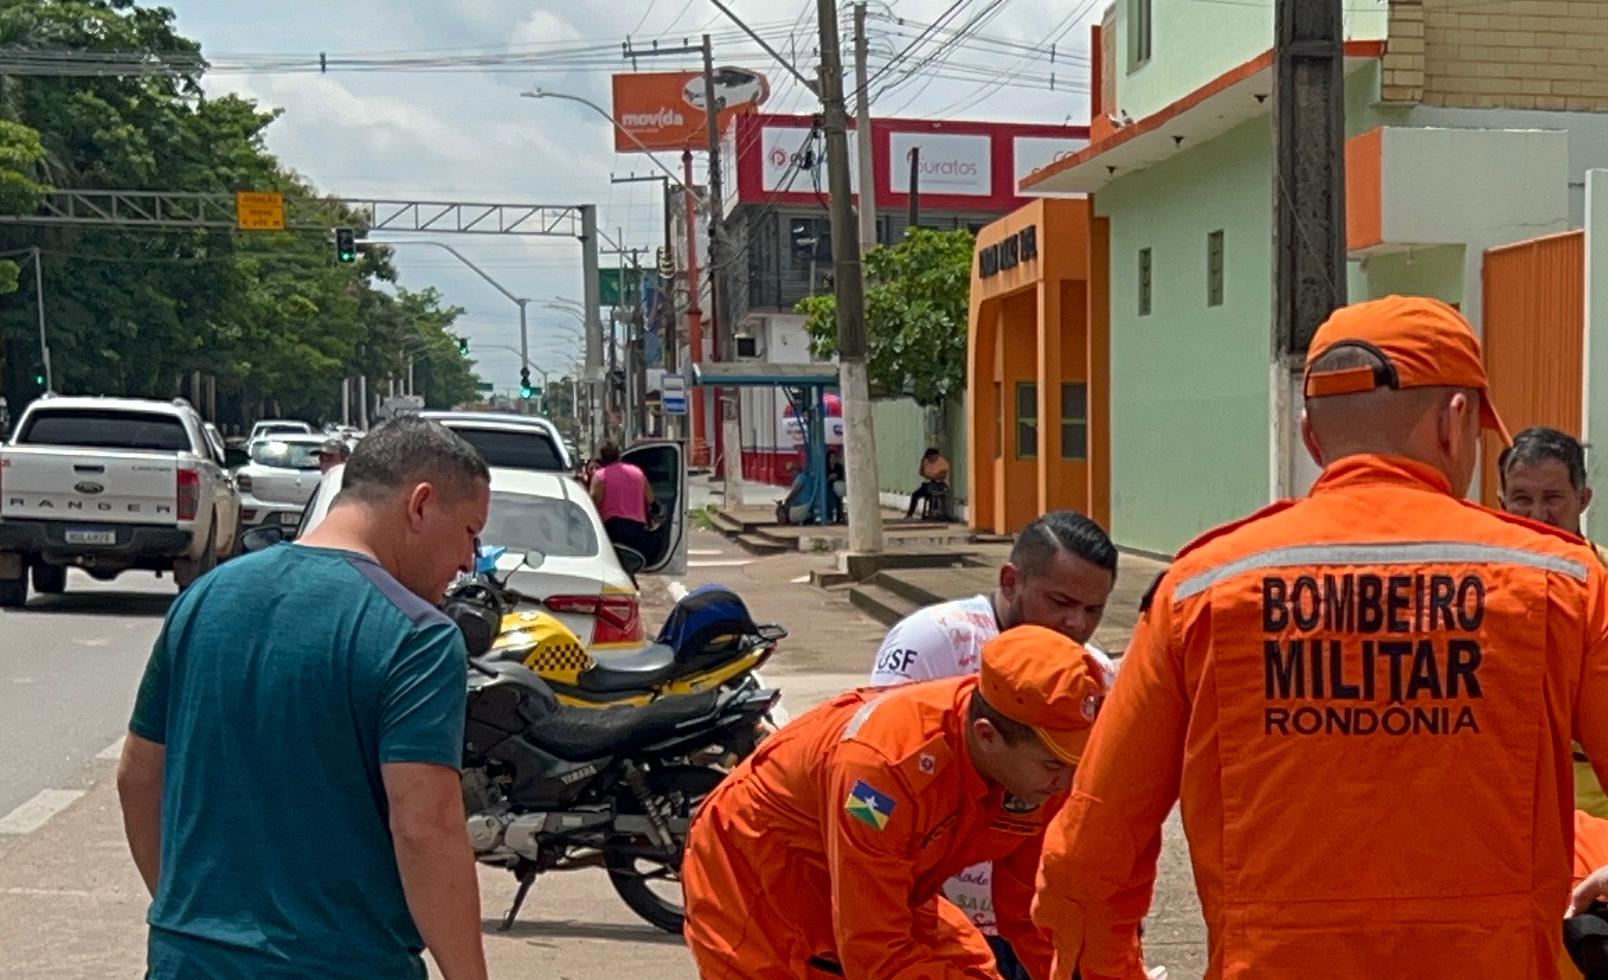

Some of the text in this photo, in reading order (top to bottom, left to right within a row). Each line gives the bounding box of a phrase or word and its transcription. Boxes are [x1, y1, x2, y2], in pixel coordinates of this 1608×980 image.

[9, 497, 171, 514] RANGER
[1262, 575, 1484, 634] BOMBEIRO
[1264, 639, 1483, 701] MILITAR
[1263, 694, 1481, 736] RONDÔNIA
[560, 764, 598, 785] YAMAHA
